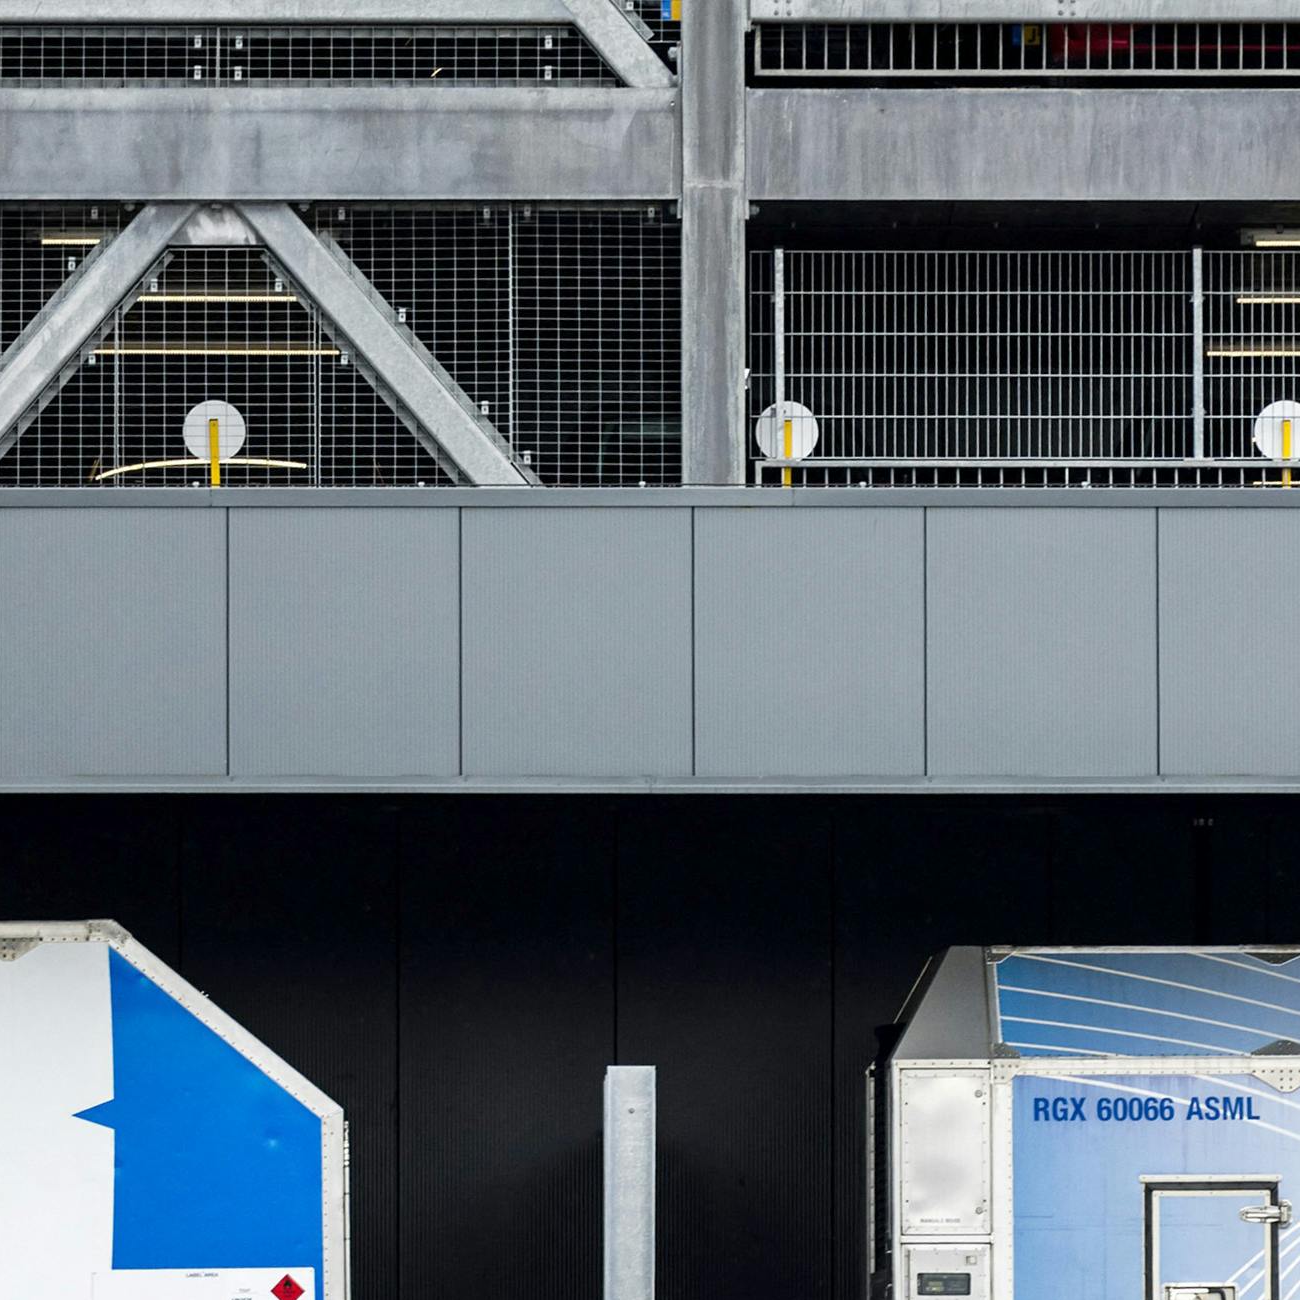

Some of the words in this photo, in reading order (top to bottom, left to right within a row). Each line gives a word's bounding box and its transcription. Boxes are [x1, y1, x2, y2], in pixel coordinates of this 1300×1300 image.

[1033, 1097, 1087, 1121] RGX
[1096, 1097, 1175, 1121] 60066
[1186, 1096, 1261, 1120] ASML
